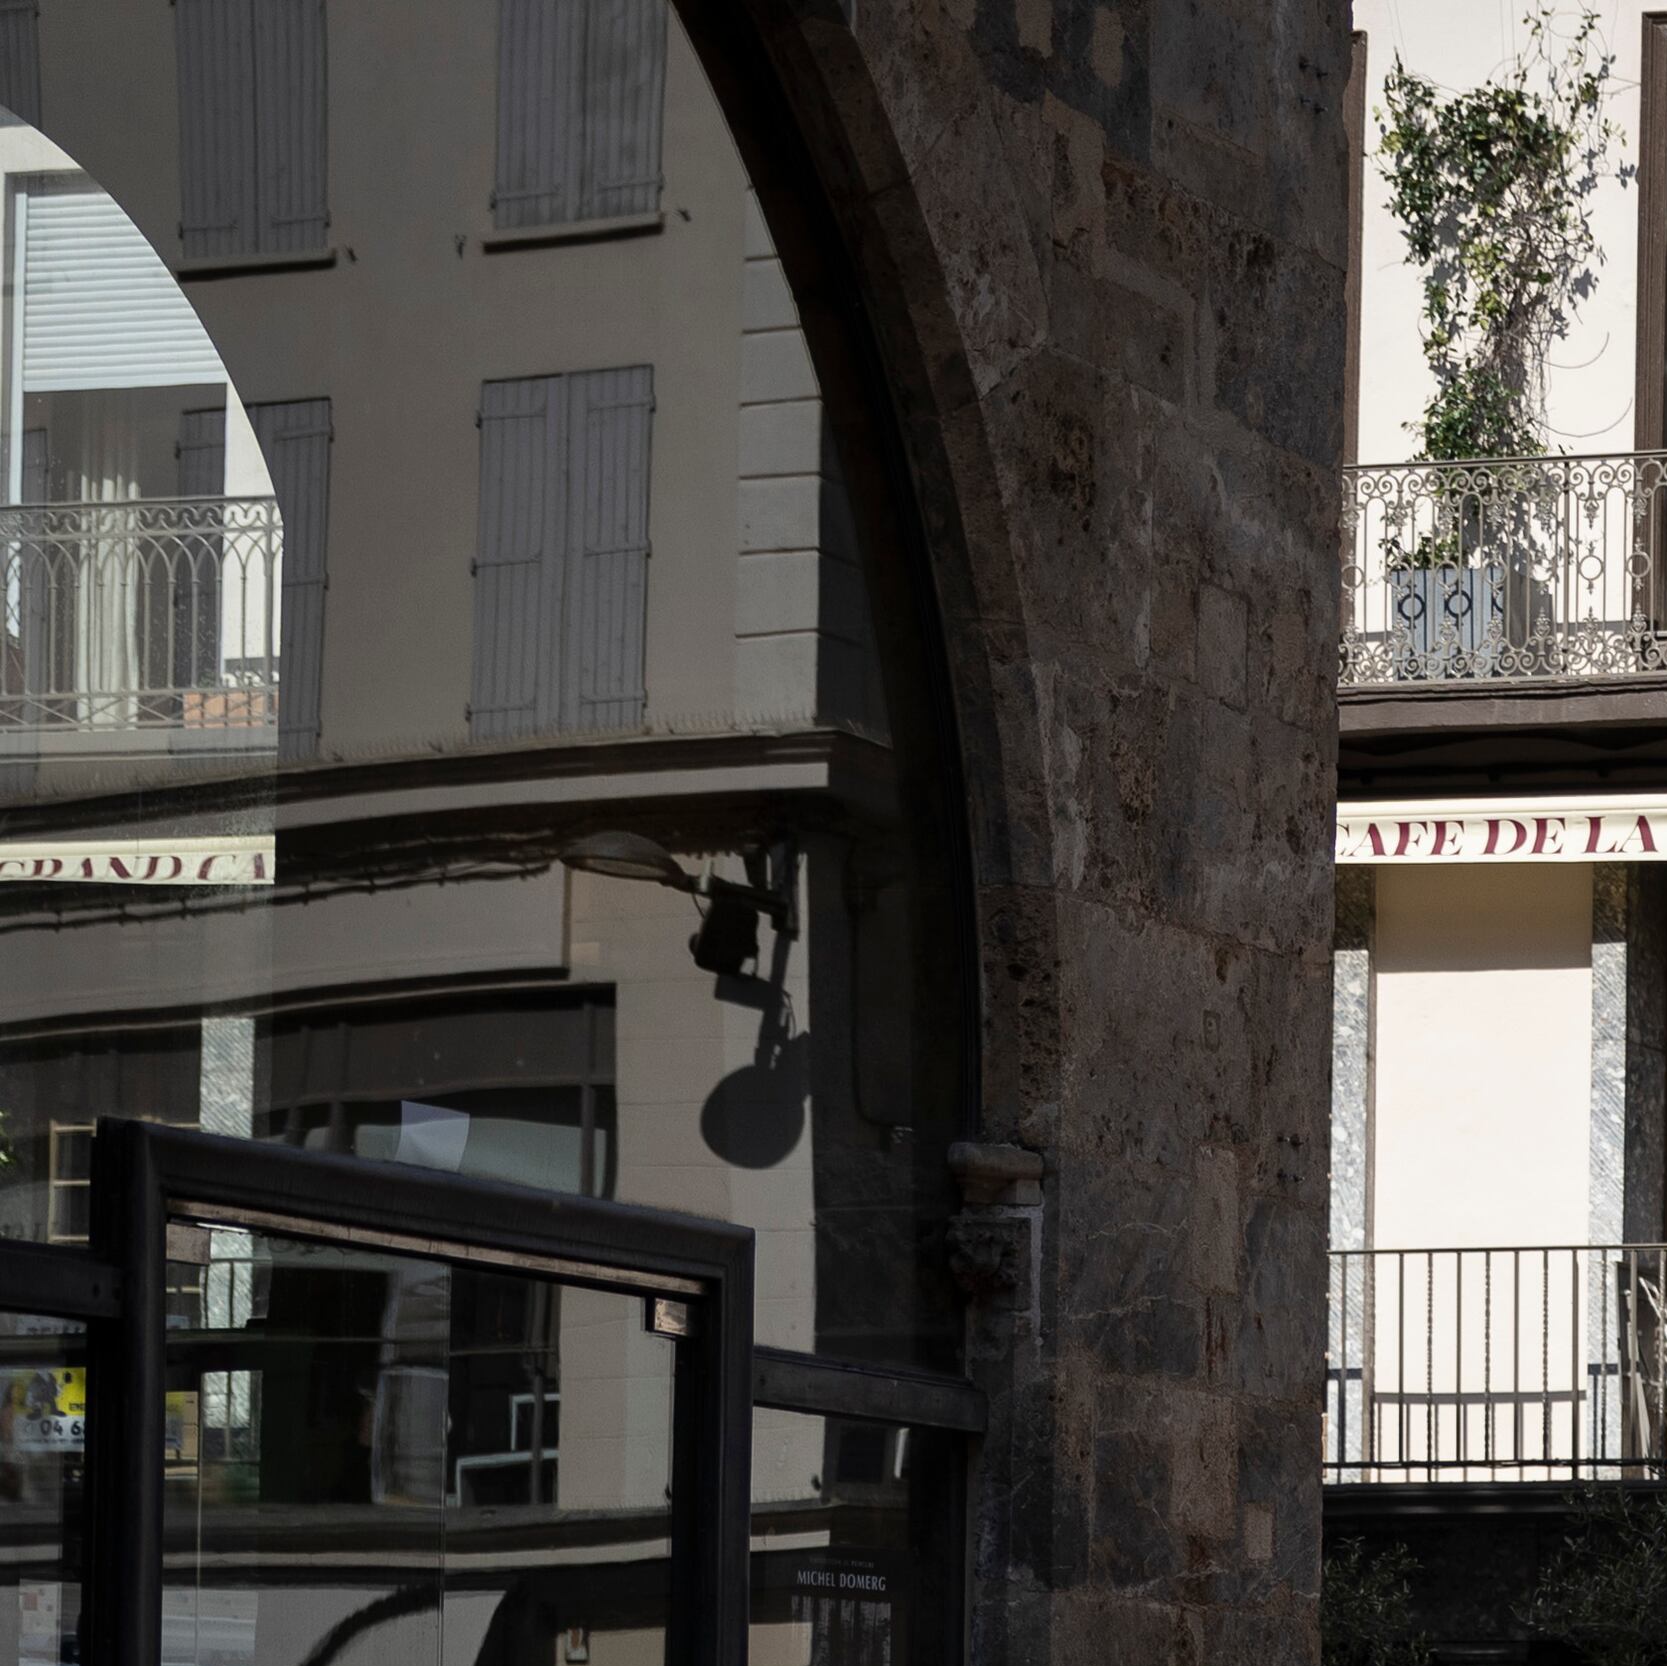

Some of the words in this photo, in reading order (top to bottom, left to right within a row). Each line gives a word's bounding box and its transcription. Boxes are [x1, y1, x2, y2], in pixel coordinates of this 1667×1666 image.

[1483, 817, 1566, 856] DE
[1581, 814, 1659, 854] LA
[70, 1420, 86, 1437] 6
[797, 1570, 837, 1588] MICHEL
[839, 1572, 887, 1592] DOMERG
